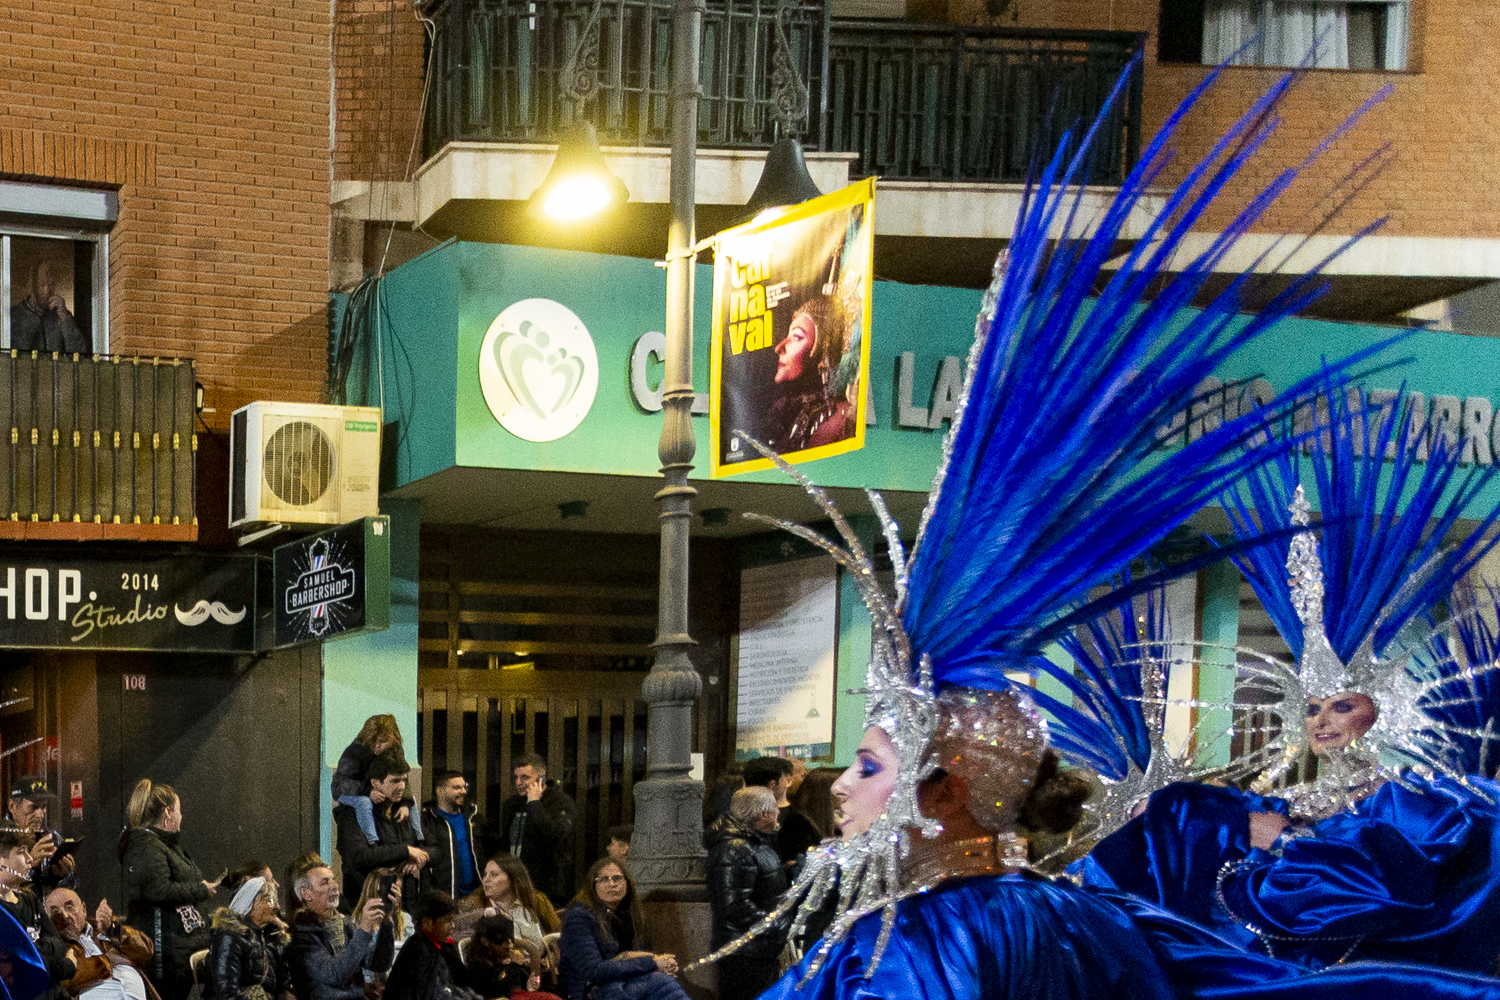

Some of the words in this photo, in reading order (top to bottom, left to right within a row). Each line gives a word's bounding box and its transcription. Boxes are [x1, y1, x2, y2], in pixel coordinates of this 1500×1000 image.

[730, 284, 766, 323] na
[729, 310, 773, 356] val
[121, 573, 159, 591] 2014
[292, 579, 348, 607] BARBERSHOP
[303, 570, 336, 589] SAMUEL
[71, 593, 168, 642] Studio
[123, 675, 146, 690] 108
